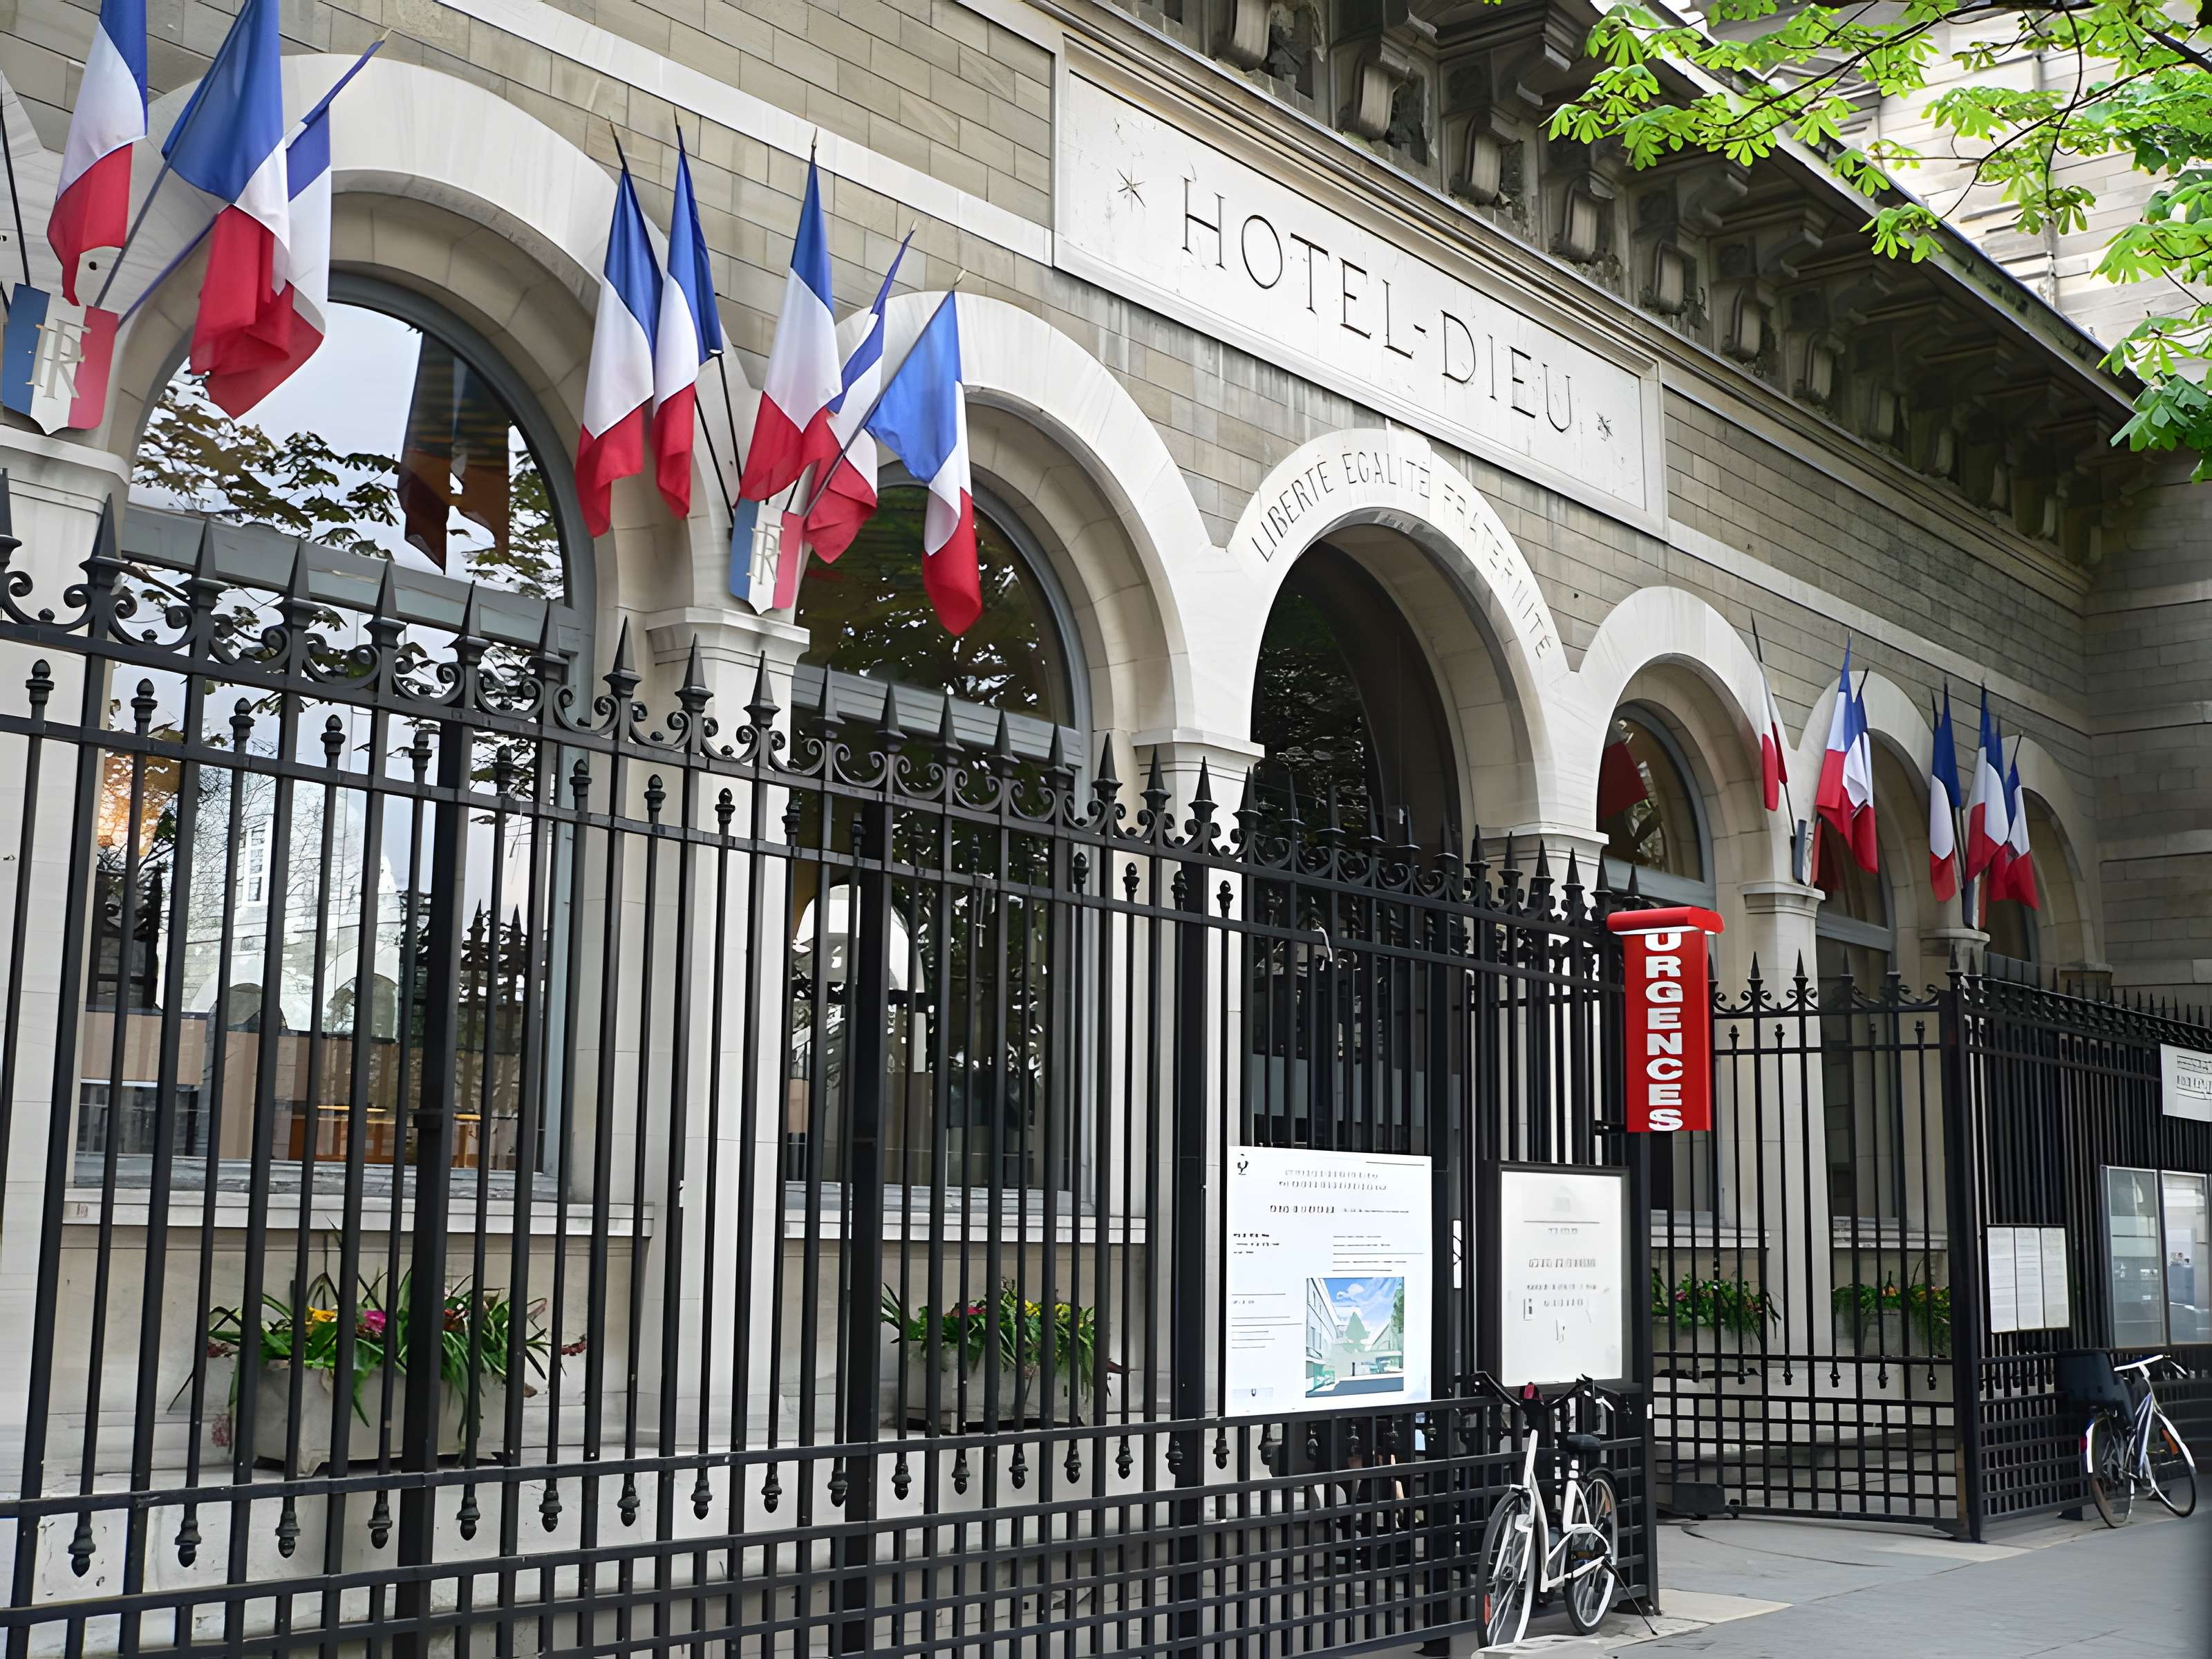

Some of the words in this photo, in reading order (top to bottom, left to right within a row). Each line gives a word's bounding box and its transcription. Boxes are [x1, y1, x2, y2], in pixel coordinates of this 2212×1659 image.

[1179, 175, 1571, 433] HOTEL-DIEU
[1251, 454, 1334, 563] LIBERTÉ
[1644, 933, 1684, 1132] URGENCES
